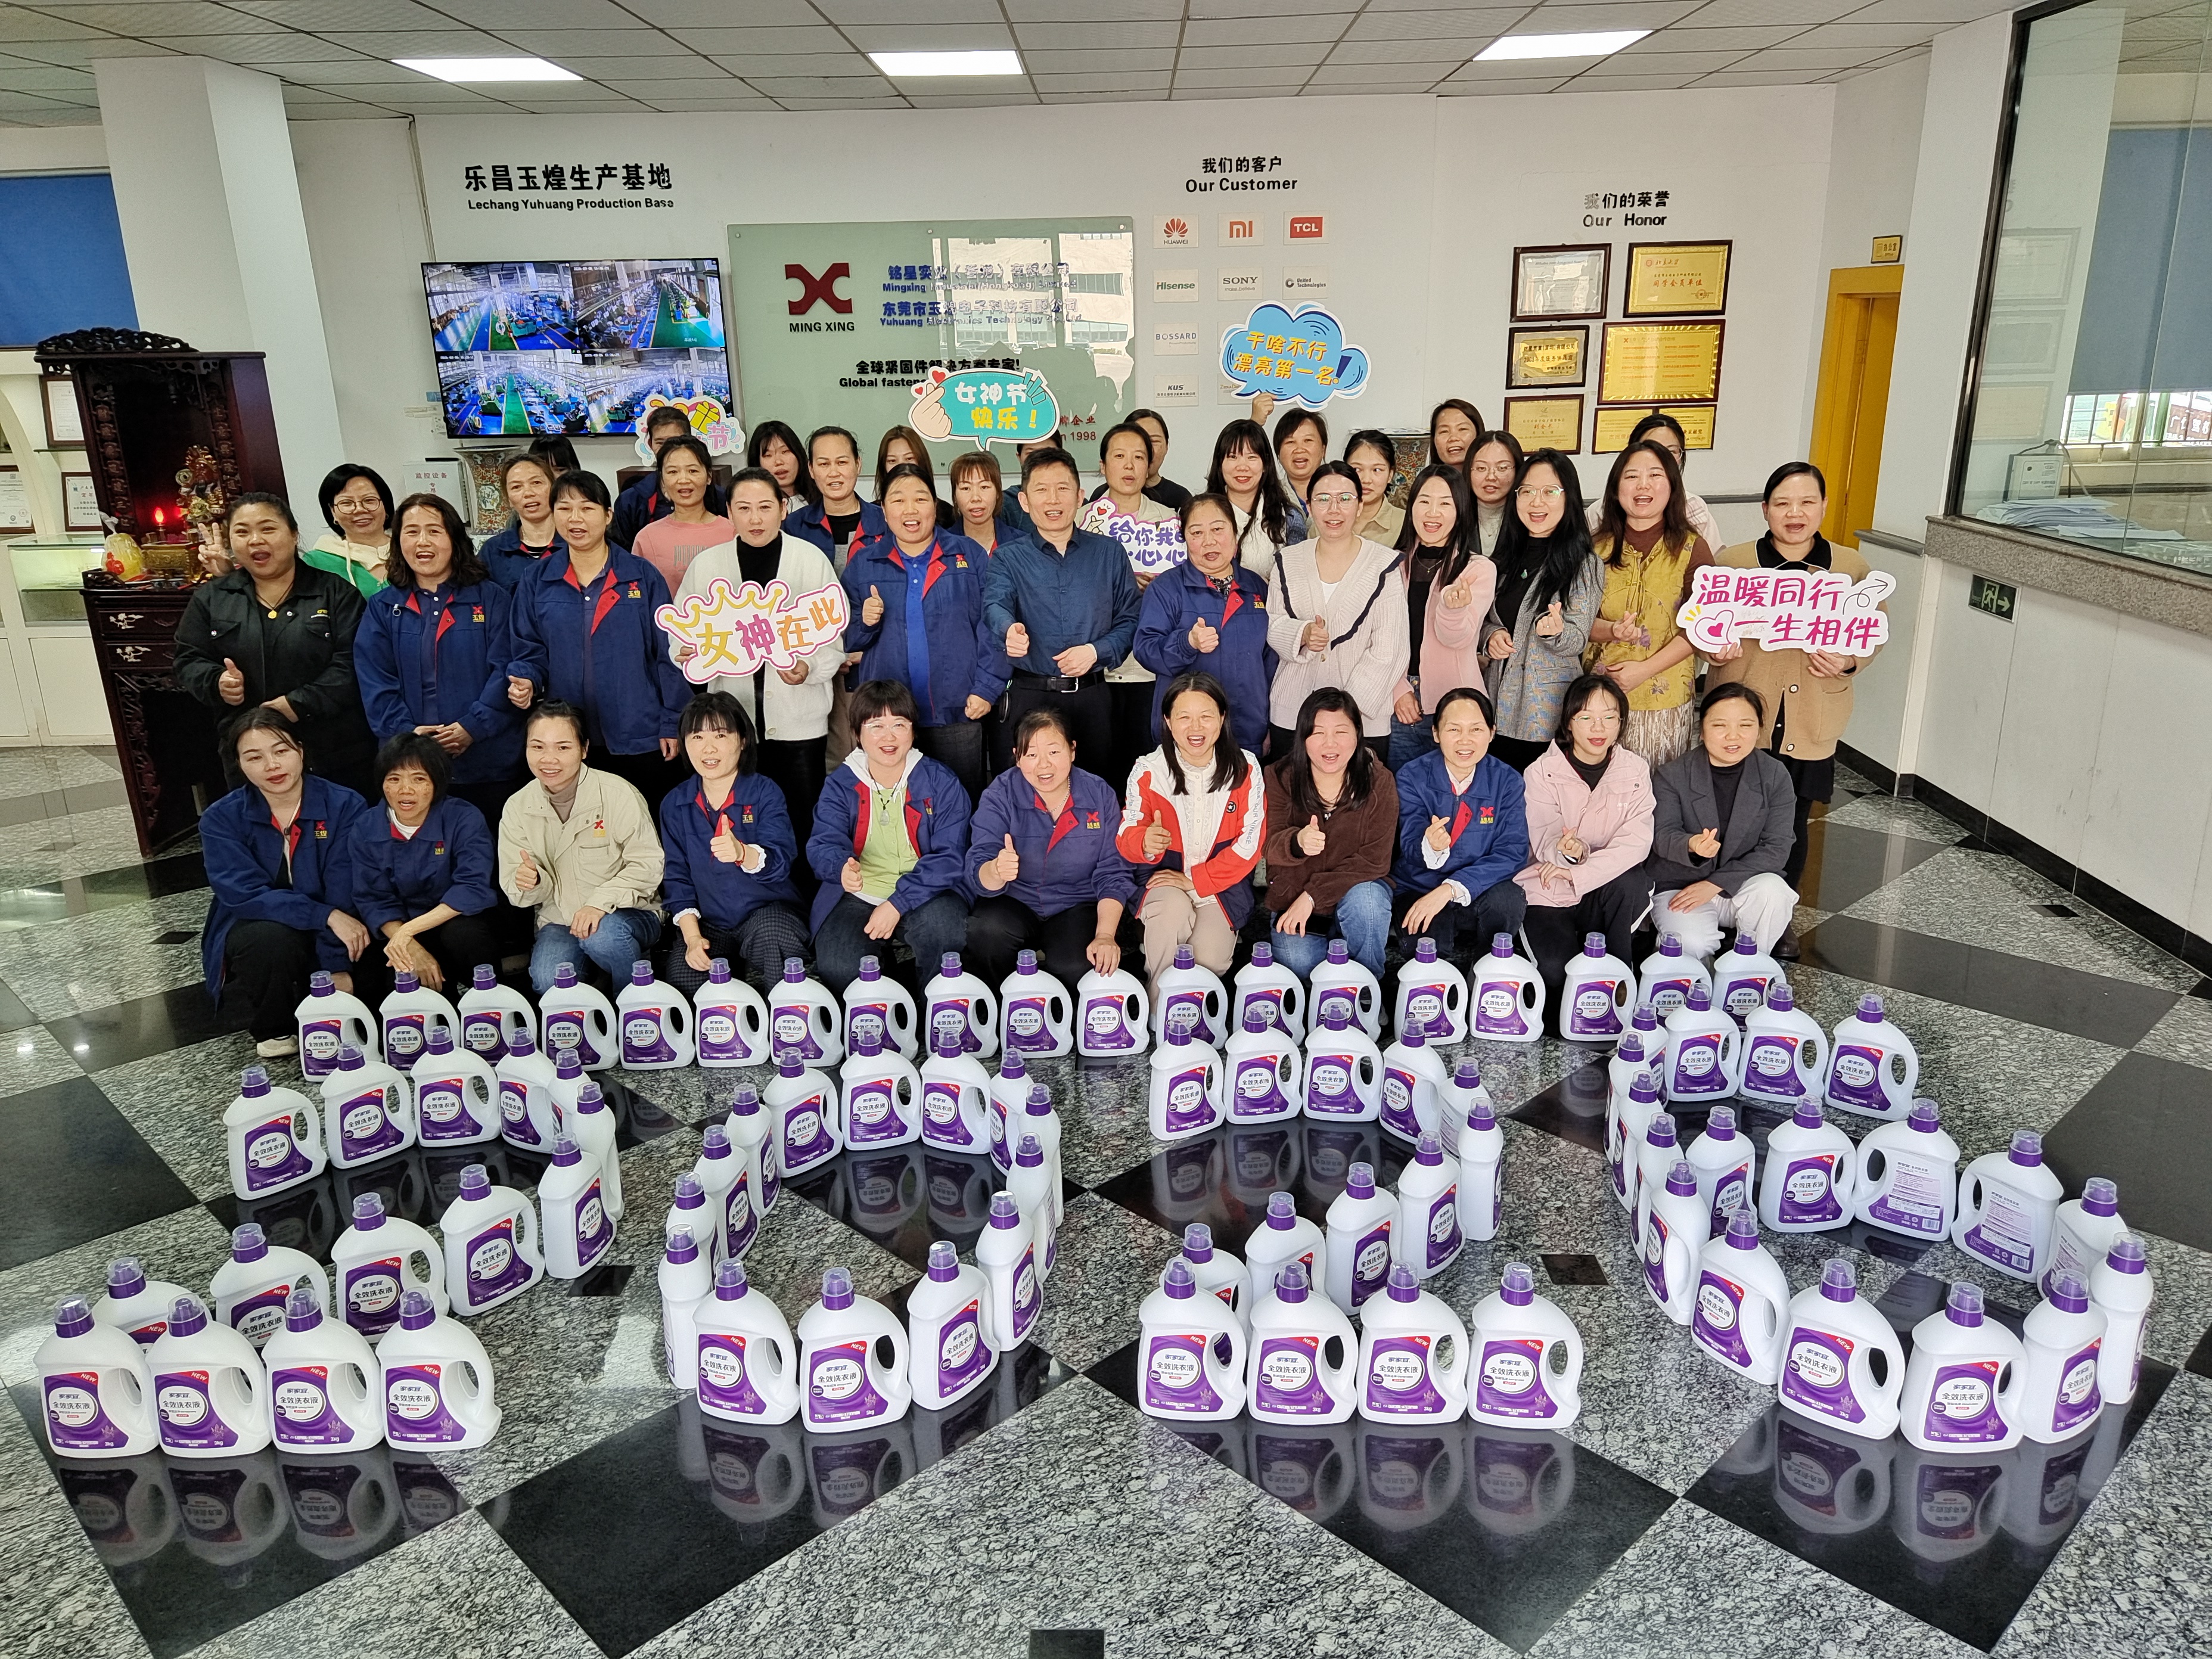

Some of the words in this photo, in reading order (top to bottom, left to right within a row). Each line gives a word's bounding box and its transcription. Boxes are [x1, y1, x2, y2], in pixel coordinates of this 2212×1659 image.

[1202, 156, 1282, 173] 我们的客户
[465, 163, 672, 191] 乐昌玉煌生产基地
[1185, 179, 1215, 192] Our
[1219, 178, 1298, 191] Customer
[468, 199, 520, 212] Lechang
[521, 200, 574, 212] Yuhuang
[576, 198, 642, 209] Production
[645, 197, 675, 208] Base
[1584, 190, 1670, 209] 我们的荣誉
[1583, 214, 1613, 227] Our
[1624, 213, 1667, 226] Honor
[1294, 223, 1319, 232] TCL
[1156, 281, 1195, 290] Hisense
[1222, 276, 1259, 285] SONY
[883, 282, 927, 293] Mingxing
[789, 322, 822, 333] MING
[825, 321, 855, 332] XING
[880, 318, 923, 327] Yuhuang
[1247, 331, 1327, 362] 干啥不行
[839, 377, 878, 387] Global
[955, 381, 1027, 406] 女神节
[1070, 431, 1096, 441] 1998
[1696, 573, 1845, 611] 温暖同行
[696, 597, 842, 669] 女神在此
[1733, 613, 1881, 650] 一生相伴
[1785, 1037, 1797, 1046] NEW
[1870, 1049, 1881, 1057] NEW
[1405, 1074, 1413, 1083] NEW
[475, 1249, 508, 1267] 全效洗衣液
[1360, 1251, 1385, 1268] 全效洗衣液
[354, 1287, 394, 1298] 全效洗衣液
[1730, 1284, 1743, 1297] NEW
[1702, 1295, 1731, 1318] 全效洗衣液
[241, 1317, 283, 1335] 全效洗衣液
[730, 1337, 745, 1347] NEW
[946, 1332, 974, 1355] 全效洗衣液
[1189, 1336, 1204, 1345] NEW
[1302, 1338, 1316, 1347] NEW
[1414, 1337, 1429, 1347] NEW
[1526, 1341, 1542, 1350] NEW
[1835, 1338, 1852, 1350] NEW
[850, 1343, 865, 1352] NEW
[704, 1359, 737, 1372] 全效洗衣液
[1157, 1362, 1195, 1371] 全效洗衣液
[1796, 1354, 1837, 1374] 全效洗衣液
[1982, 1363, 1996, 1372] NEW
[310, 1367, 326, 1377] NEW
[423, 1366, 439, 1375] NEW
[1268, 1365, 1306, 1374] 全效洗衣液
[1379, 1365, 1418, 1374] 全效洗衣液
[1490, 1367, 1530, 1377] 全效洗衣液
[80, 1373, 97, 1382] NEW
[191, 1372, 207, 1381] NEW
[818, 1372, 857, 1383] 全效洗衣液
[2067, 1372, 2093, 1390] 全效洗衣液
[1942, 1393, 1984, 1401] 全效洗衣液
[52, 1401, 91, 1409] 全效洗衣液
[163, 1400, 201, 1409] 全效洗衣液
